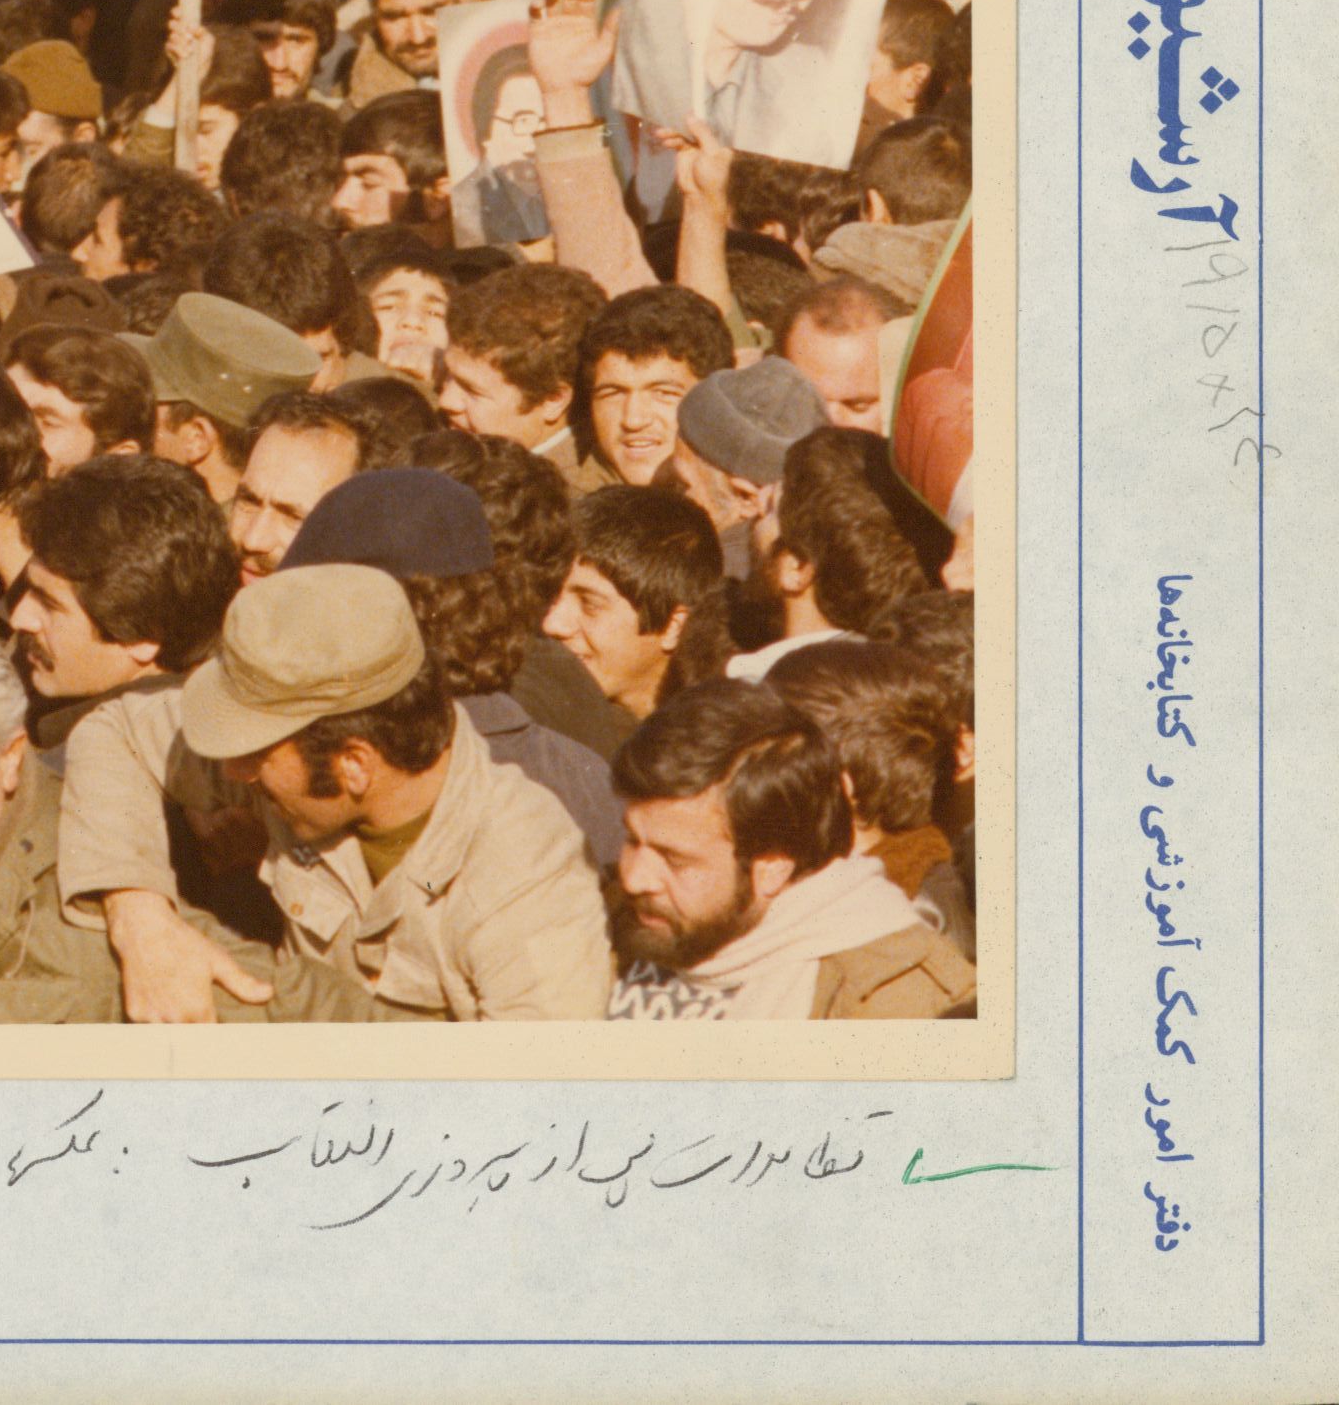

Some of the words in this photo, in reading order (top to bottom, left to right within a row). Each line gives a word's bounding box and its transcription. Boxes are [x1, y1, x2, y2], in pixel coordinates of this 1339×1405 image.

[1148, 765, 1176, 787] و
[1140, 805, 1201, 951] آموزشی
[1155, 966, 1198, 1064] کمک
[188, 1099, 394, 1189] انقلاب
[535, 1119, 587, 1184] از
[1144, 1084, 1193, 1162] امور
[578, 1130, 653, 1207] پس
[1144, 1181, 1193, 1253] دفتر
